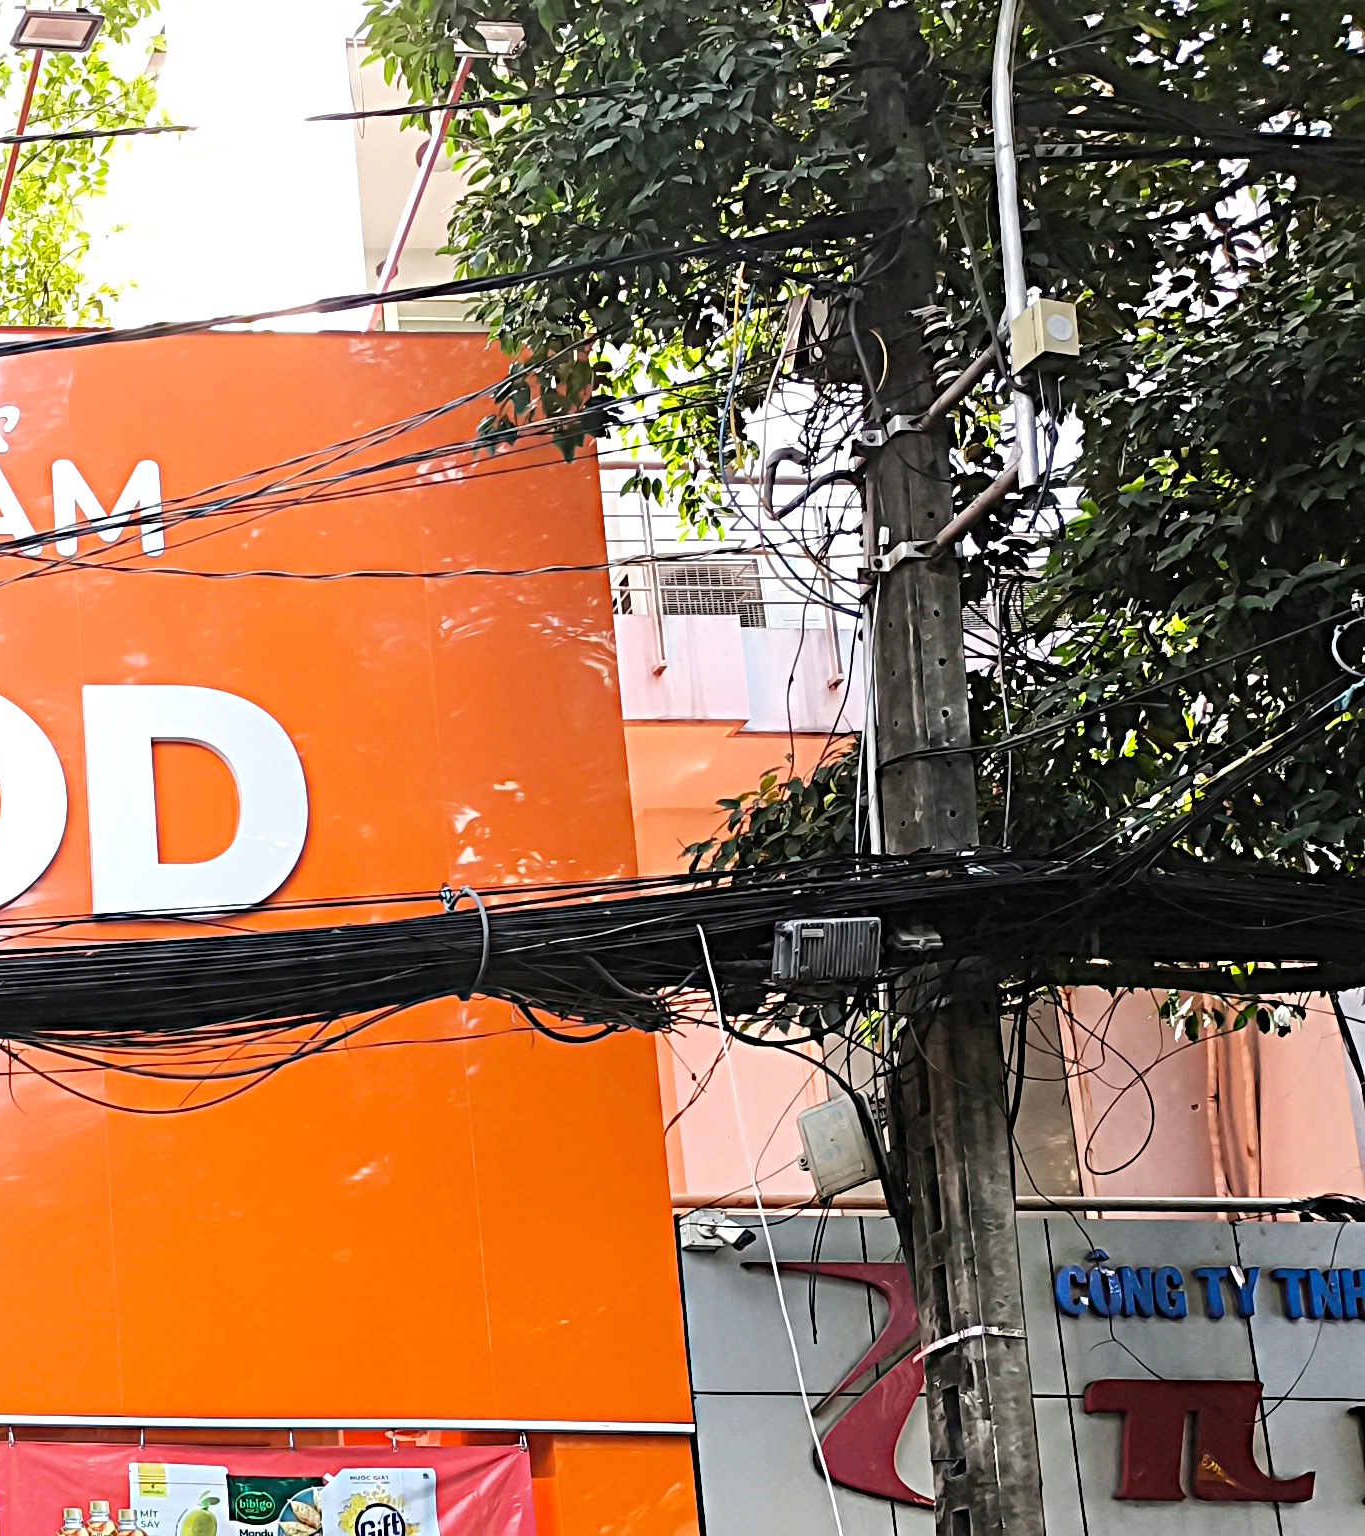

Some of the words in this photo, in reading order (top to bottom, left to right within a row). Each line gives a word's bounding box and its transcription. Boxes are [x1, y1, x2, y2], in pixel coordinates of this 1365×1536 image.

[1056, 1248, 1187, 1319] CÔNG
[1193, 1265, 1260, 1320] TY
[239, 1499, 273, 1511] bibigo
